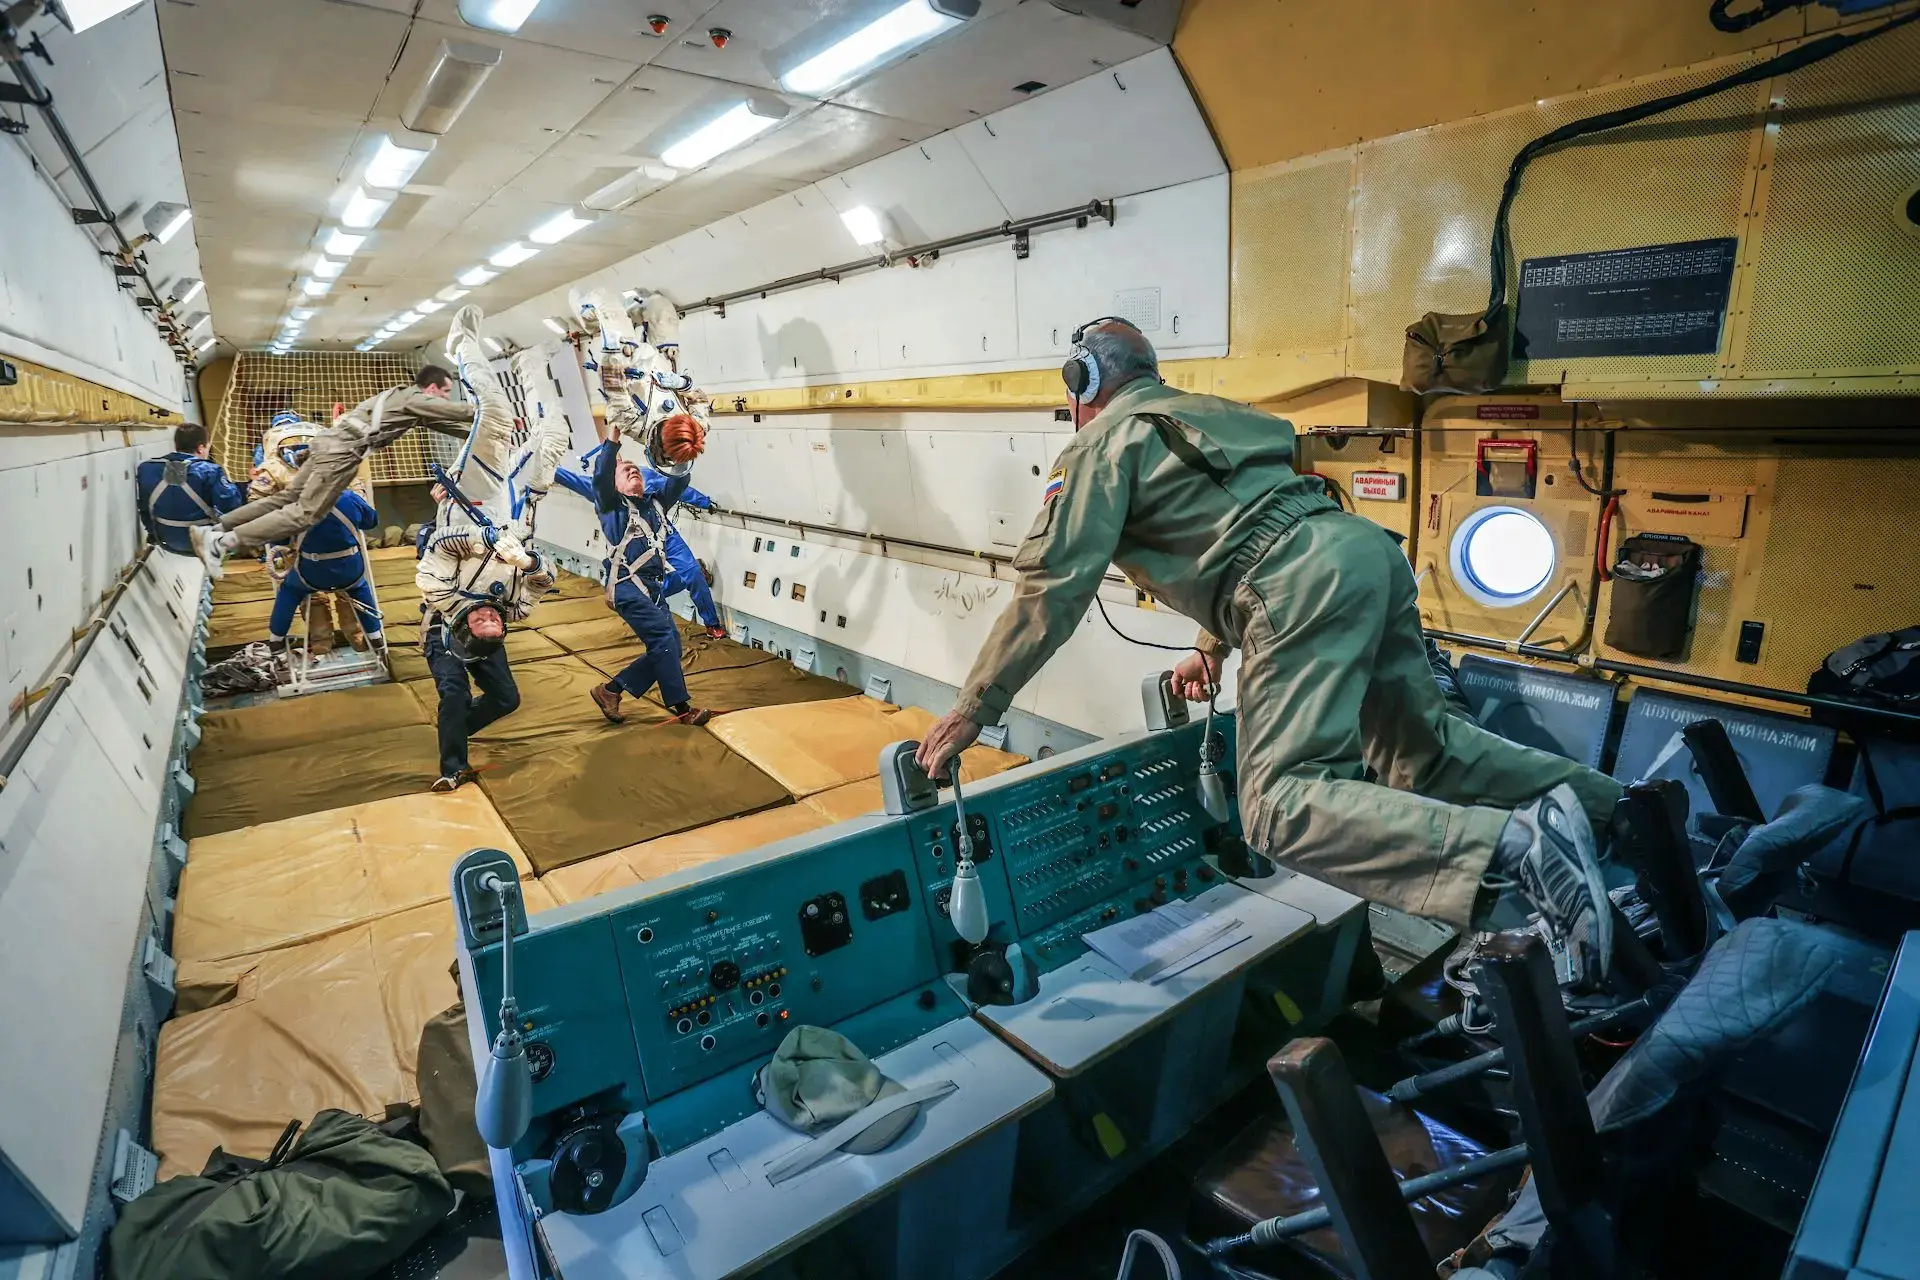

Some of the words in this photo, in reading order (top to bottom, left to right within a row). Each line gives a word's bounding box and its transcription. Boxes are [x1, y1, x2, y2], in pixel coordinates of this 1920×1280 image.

[1354, 476, 1396, 486] АВАРИЙНЫЙ
[1362, 486, 1387, 496] ВЫХОД
[1646, 507, 1687, 516] АВАРИЙНЫЙ
[1464, 671, 1488, 689] ДЛЯ
[1554, 688, 1601, 711] НАЖМИ
[1640, 701, 1670, 721] ДЛЯ
[1671, 708, 1756, 738] ОПУНИЯ
[1757, 727, 1817, 752] НАЖМИ
